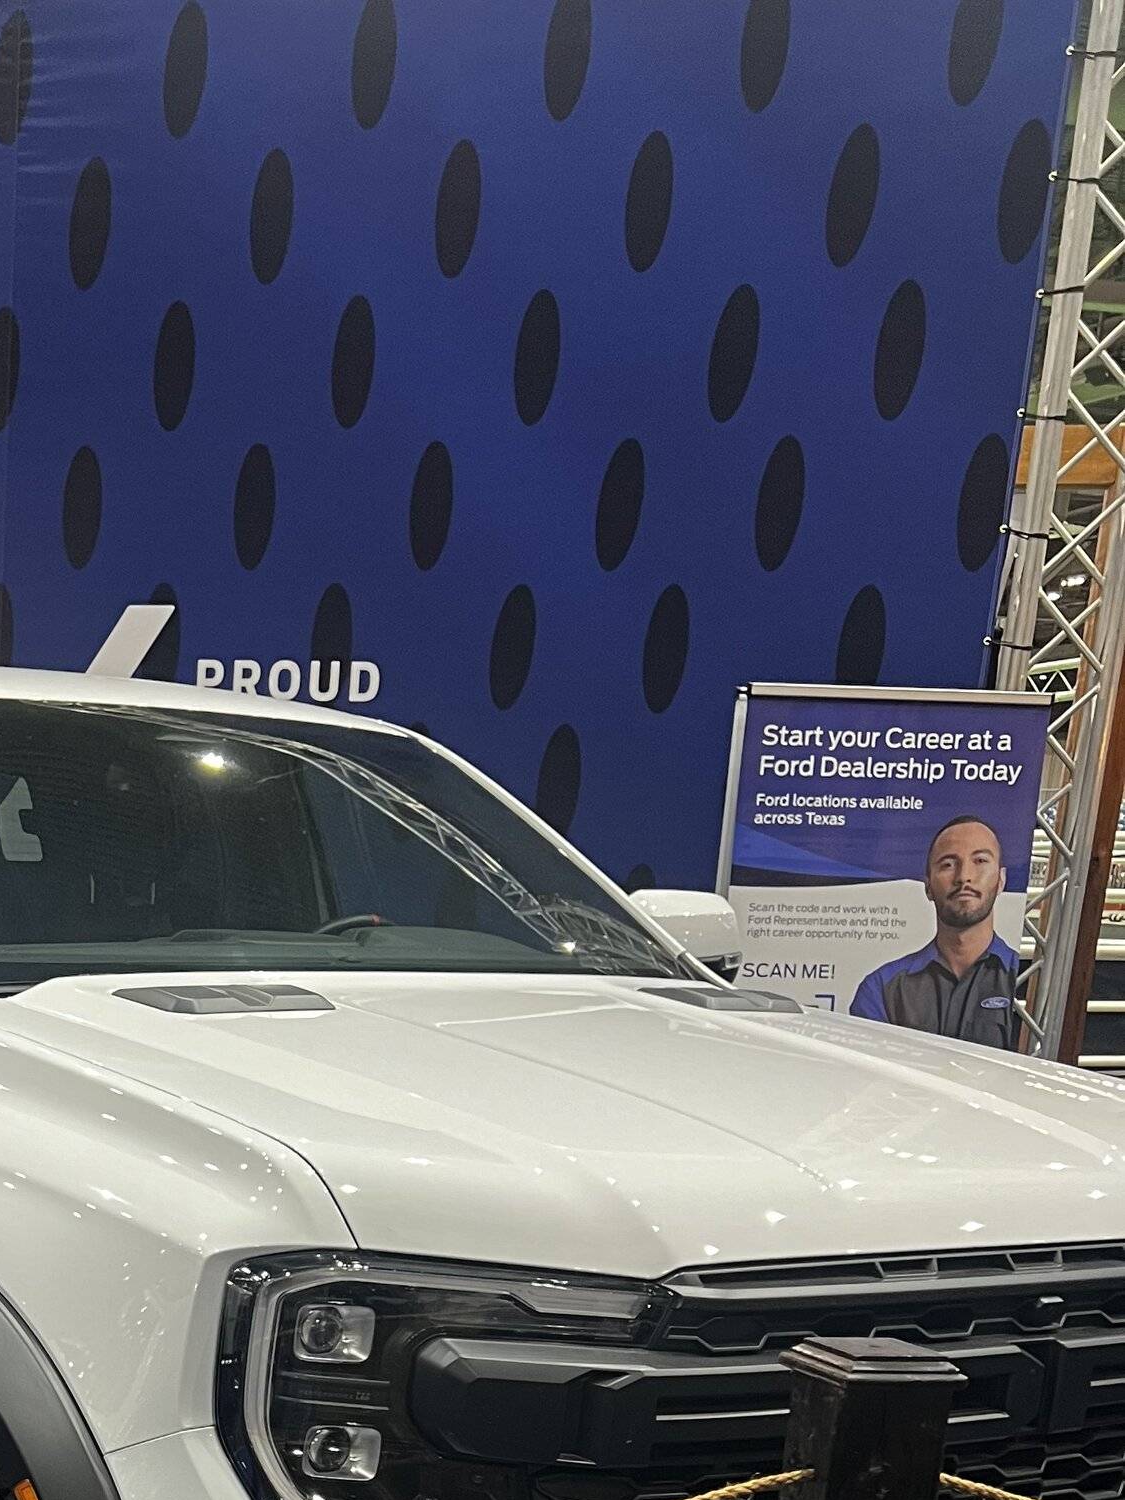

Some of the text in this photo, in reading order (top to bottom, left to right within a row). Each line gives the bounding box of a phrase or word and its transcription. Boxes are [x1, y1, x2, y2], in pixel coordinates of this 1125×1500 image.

[196, 659, 381, 703] PROUD
[762, 724, 1012, 751] Start your Career at a
[759, 755, 1023, 786] Ford Dealership Today
[755, 793, 924, 810] Ford locations available
[754, 811, 846, 826] across Texas
[748, 902, 898, 915] Scan the code and work with a
[747, 915, 907, 928] Ford Representative and find the
[746, 927, 900, 941] right career opportunity for you.
[742, 962, 835, 979] SCAN ME!
